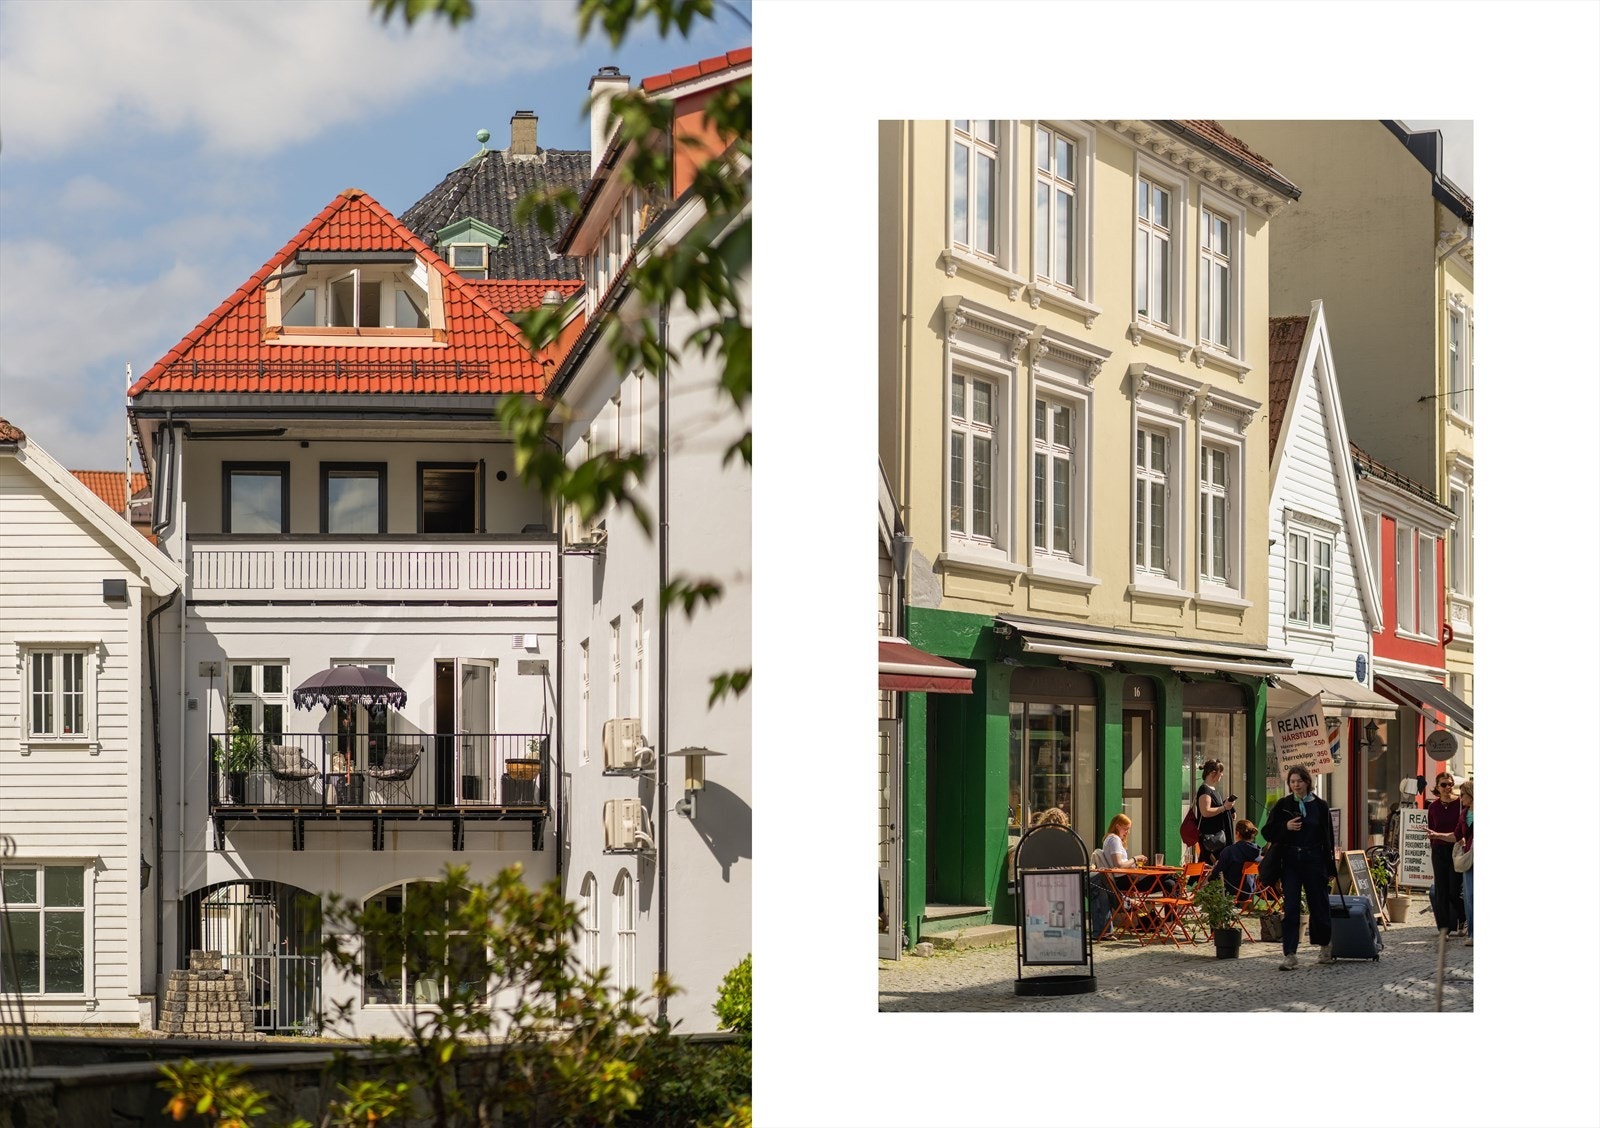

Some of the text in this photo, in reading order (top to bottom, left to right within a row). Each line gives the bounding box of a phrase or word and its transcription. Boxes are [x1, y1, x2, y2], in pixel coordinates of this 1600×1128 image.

[1133, 686, 1141, 697] 16
[1277, 714, 1319, 733] REANTI
[1282, 752, 1314, 762] Herreklipp
[1318, 757, 1331, 765] 499
[1409, 813, 1428, 824] REA
